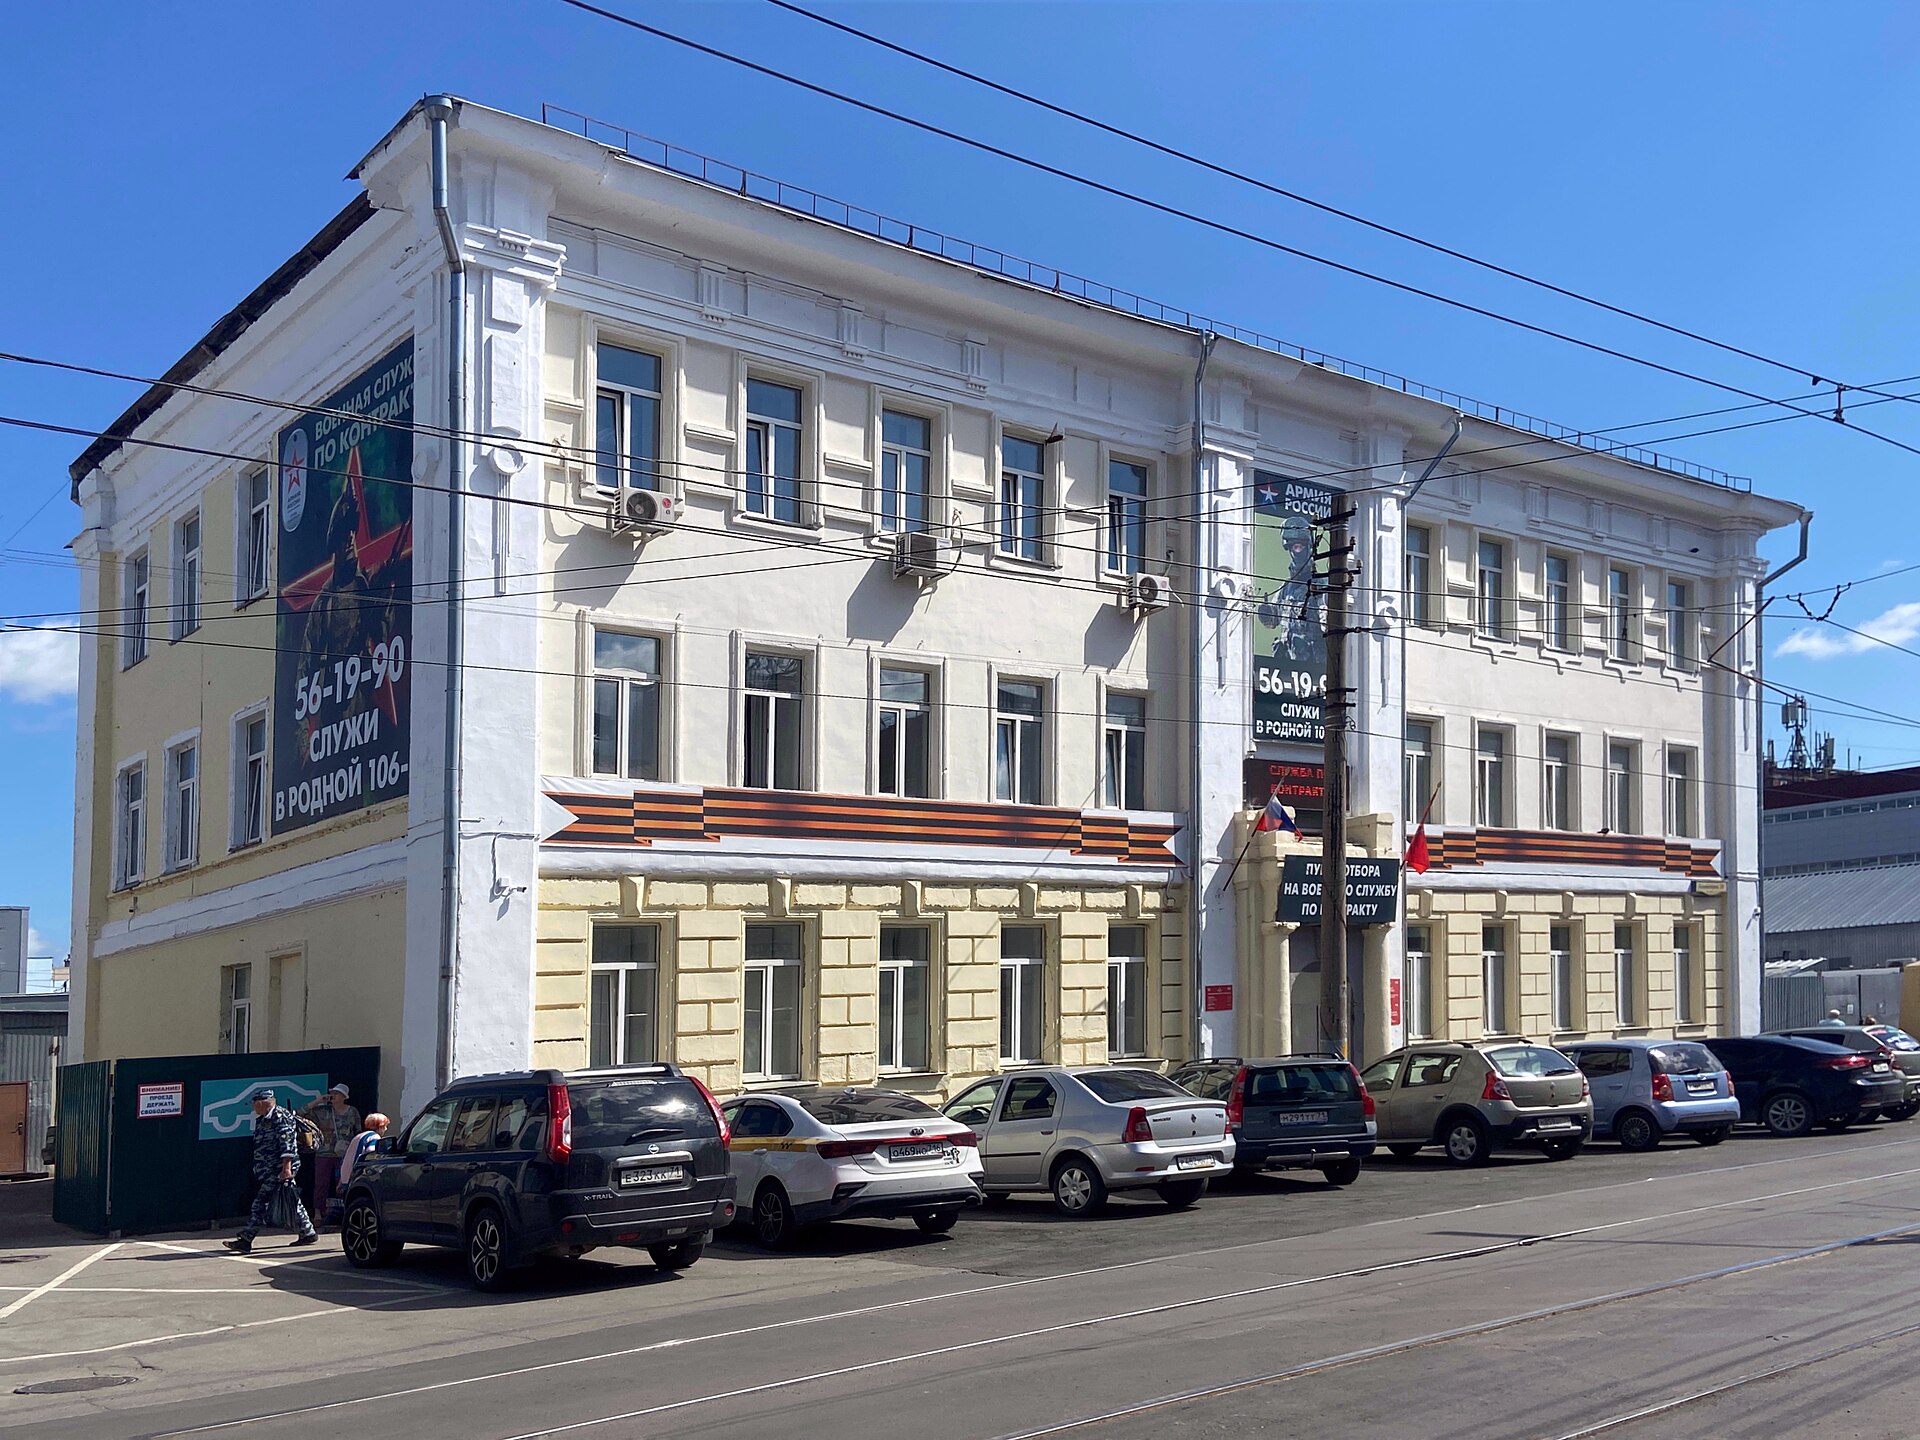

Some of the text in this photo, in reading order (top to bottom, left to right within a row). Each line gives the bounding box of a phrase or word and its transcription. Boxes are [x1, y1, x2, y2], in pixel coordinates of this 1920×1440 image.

[315, 385, 371, 441] ВОЕННАЯ
[314, 438, 336, 469] ПО
[1285, 483, 1332, 505] АРМИЯ
[1284, 497, 1332, 519] РОССИИ
[295, 635, 405, 720] 56-19-90
[1281, 702, 1320, 720] СЛУЖИ
[309, 707, 379, 762] СЛУЖИ
[1256, 720, 1264, 734] В
[1266, 721, 1312, 738] РОДНОЙ
[1270, 765, 1314, 778] СЛЖБА
[275, 750, 408, 821] В РОДНОЙ 106-
[1284, 882, 1299, 895] НА
[1355, 884, 1397, 897] СЛУЖБУ
[1301, 903, 1318, 915] ПО
[583, 1193, 613, 1201] X-TRAIL
